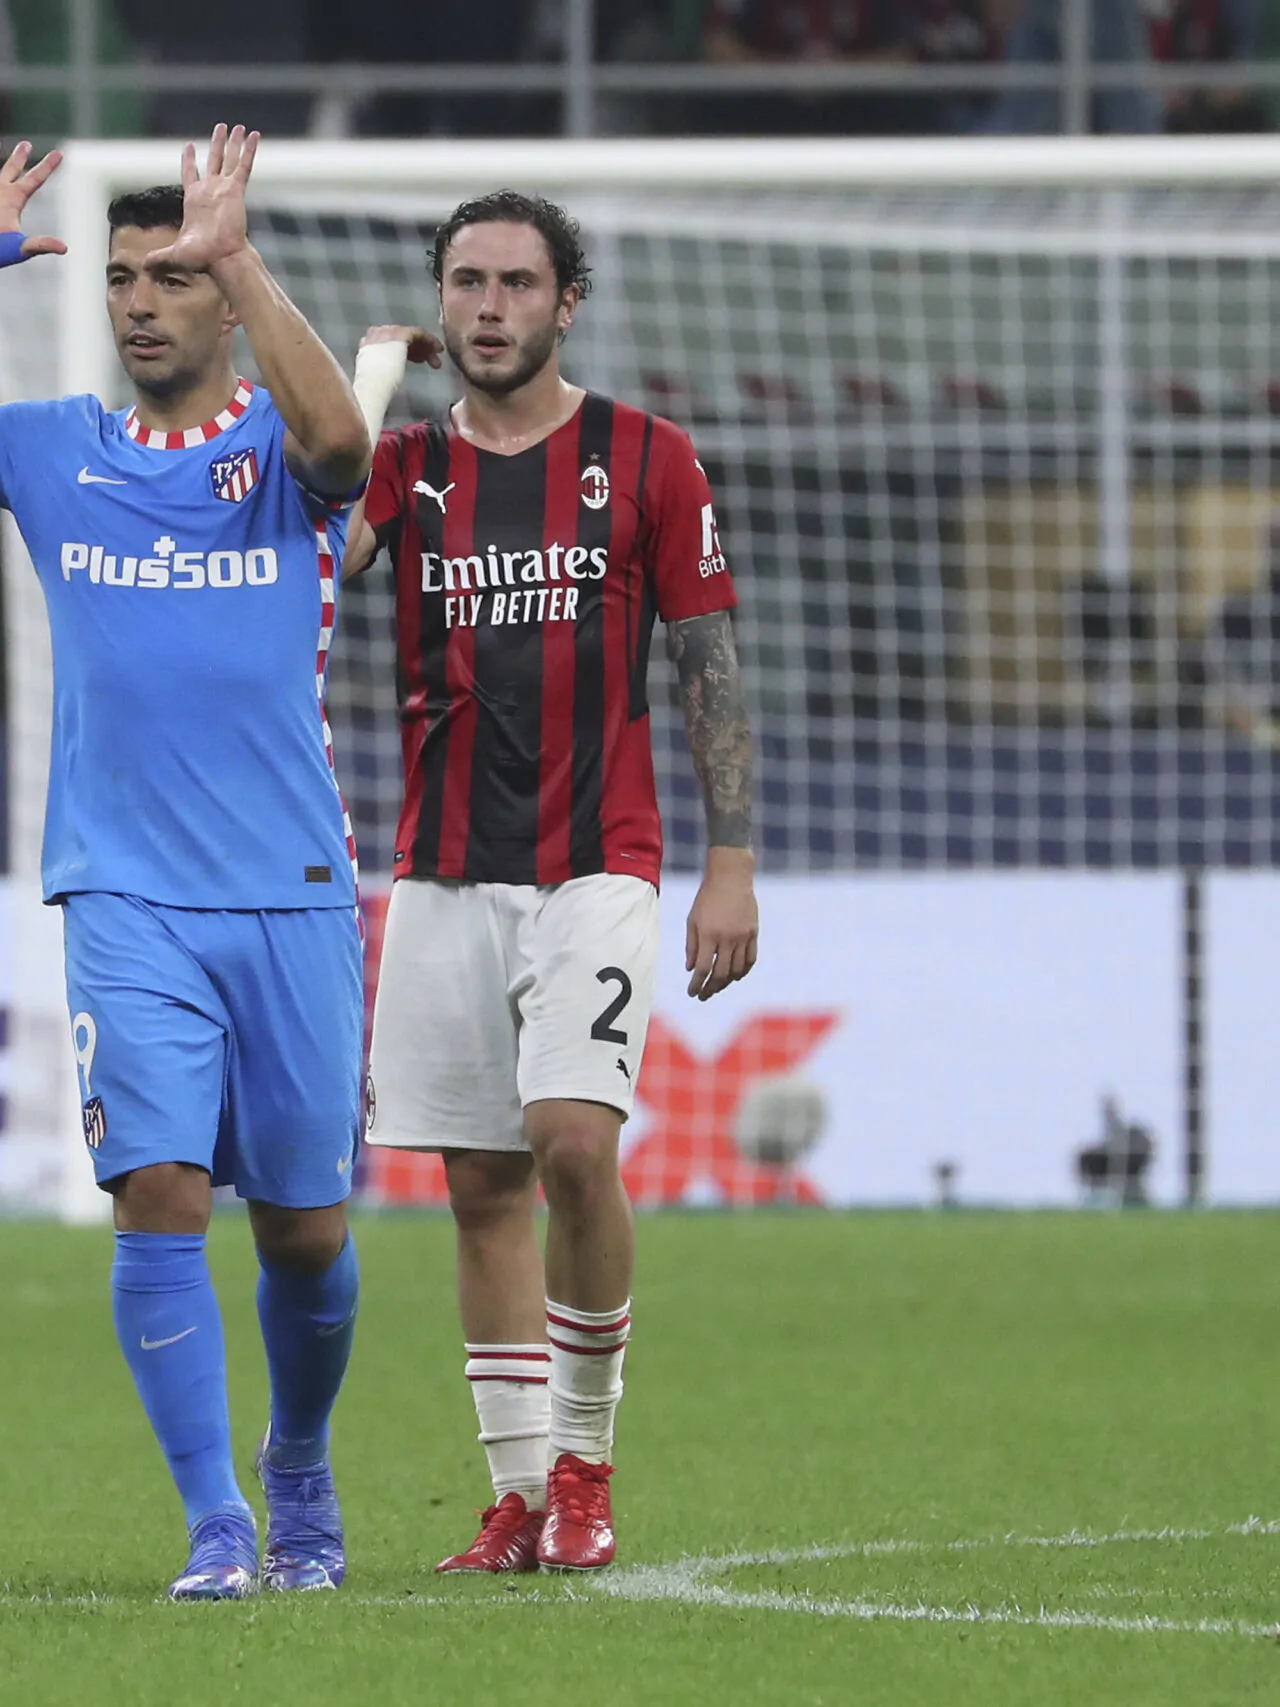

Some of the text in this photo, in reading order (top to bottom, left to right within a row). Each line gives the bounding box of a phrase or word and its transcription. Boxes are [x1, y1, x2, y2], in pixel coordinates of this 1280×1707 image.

[60, 536, 278, 589] Plus500
[421, 541, 608, 592] Emirates
[445, 587, 579, 629] FLY BETTER
[590, 966, 632, 1045] 2
[73, 1012, 97, 1095] 9
